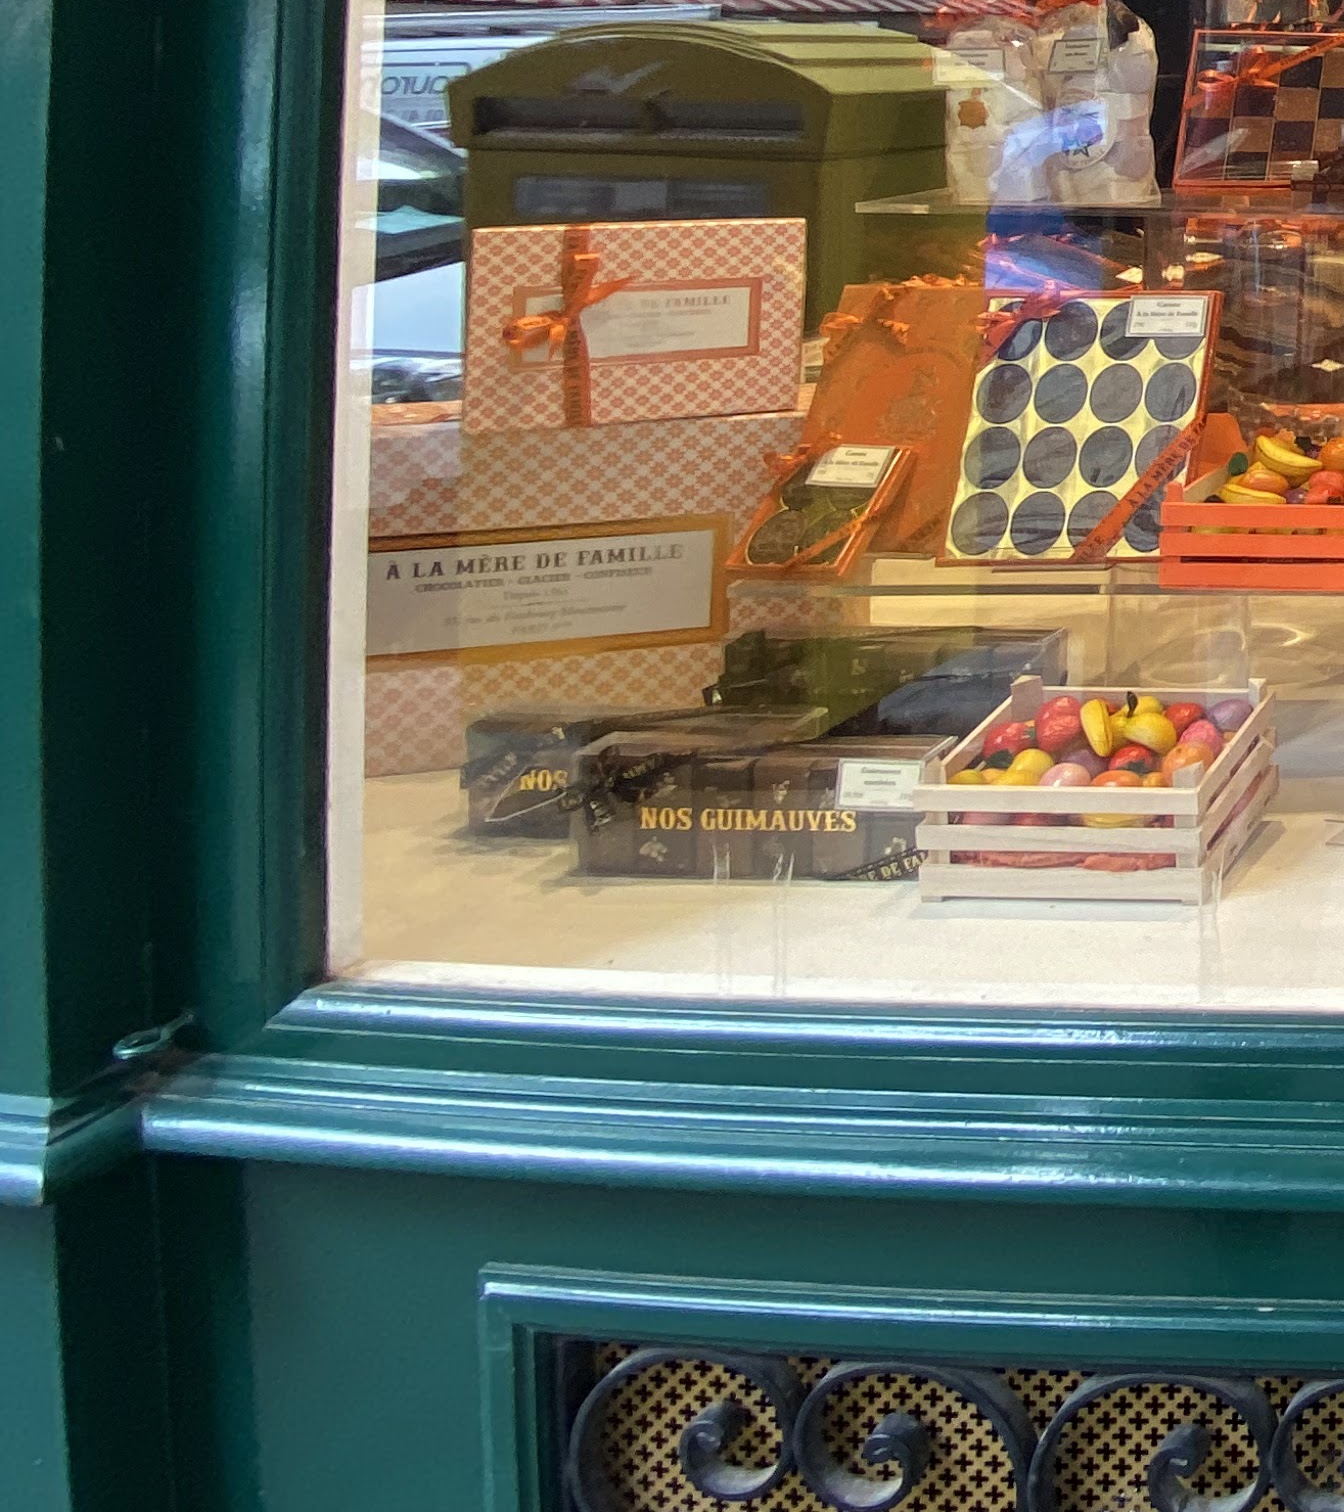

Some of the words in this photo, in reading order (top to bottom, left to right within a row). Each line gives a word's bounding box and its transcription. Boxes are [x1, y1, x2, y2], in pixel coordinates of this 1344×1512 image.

[412, 560, 445, 580] LA
[455, 553, 527, 576] MÈRE
[535, 550, 569, 571] DE
[577, 543, 685, 567] FAMILLE
[414, 577, 504, 593] CHOCOLATIER
[517, 572, 571, 586] GLACIER
[519, 770, 568, 792] NOS
[640, 807, 694, 832] NOS
[700, 809, 858, 833] GUIMAUVES
